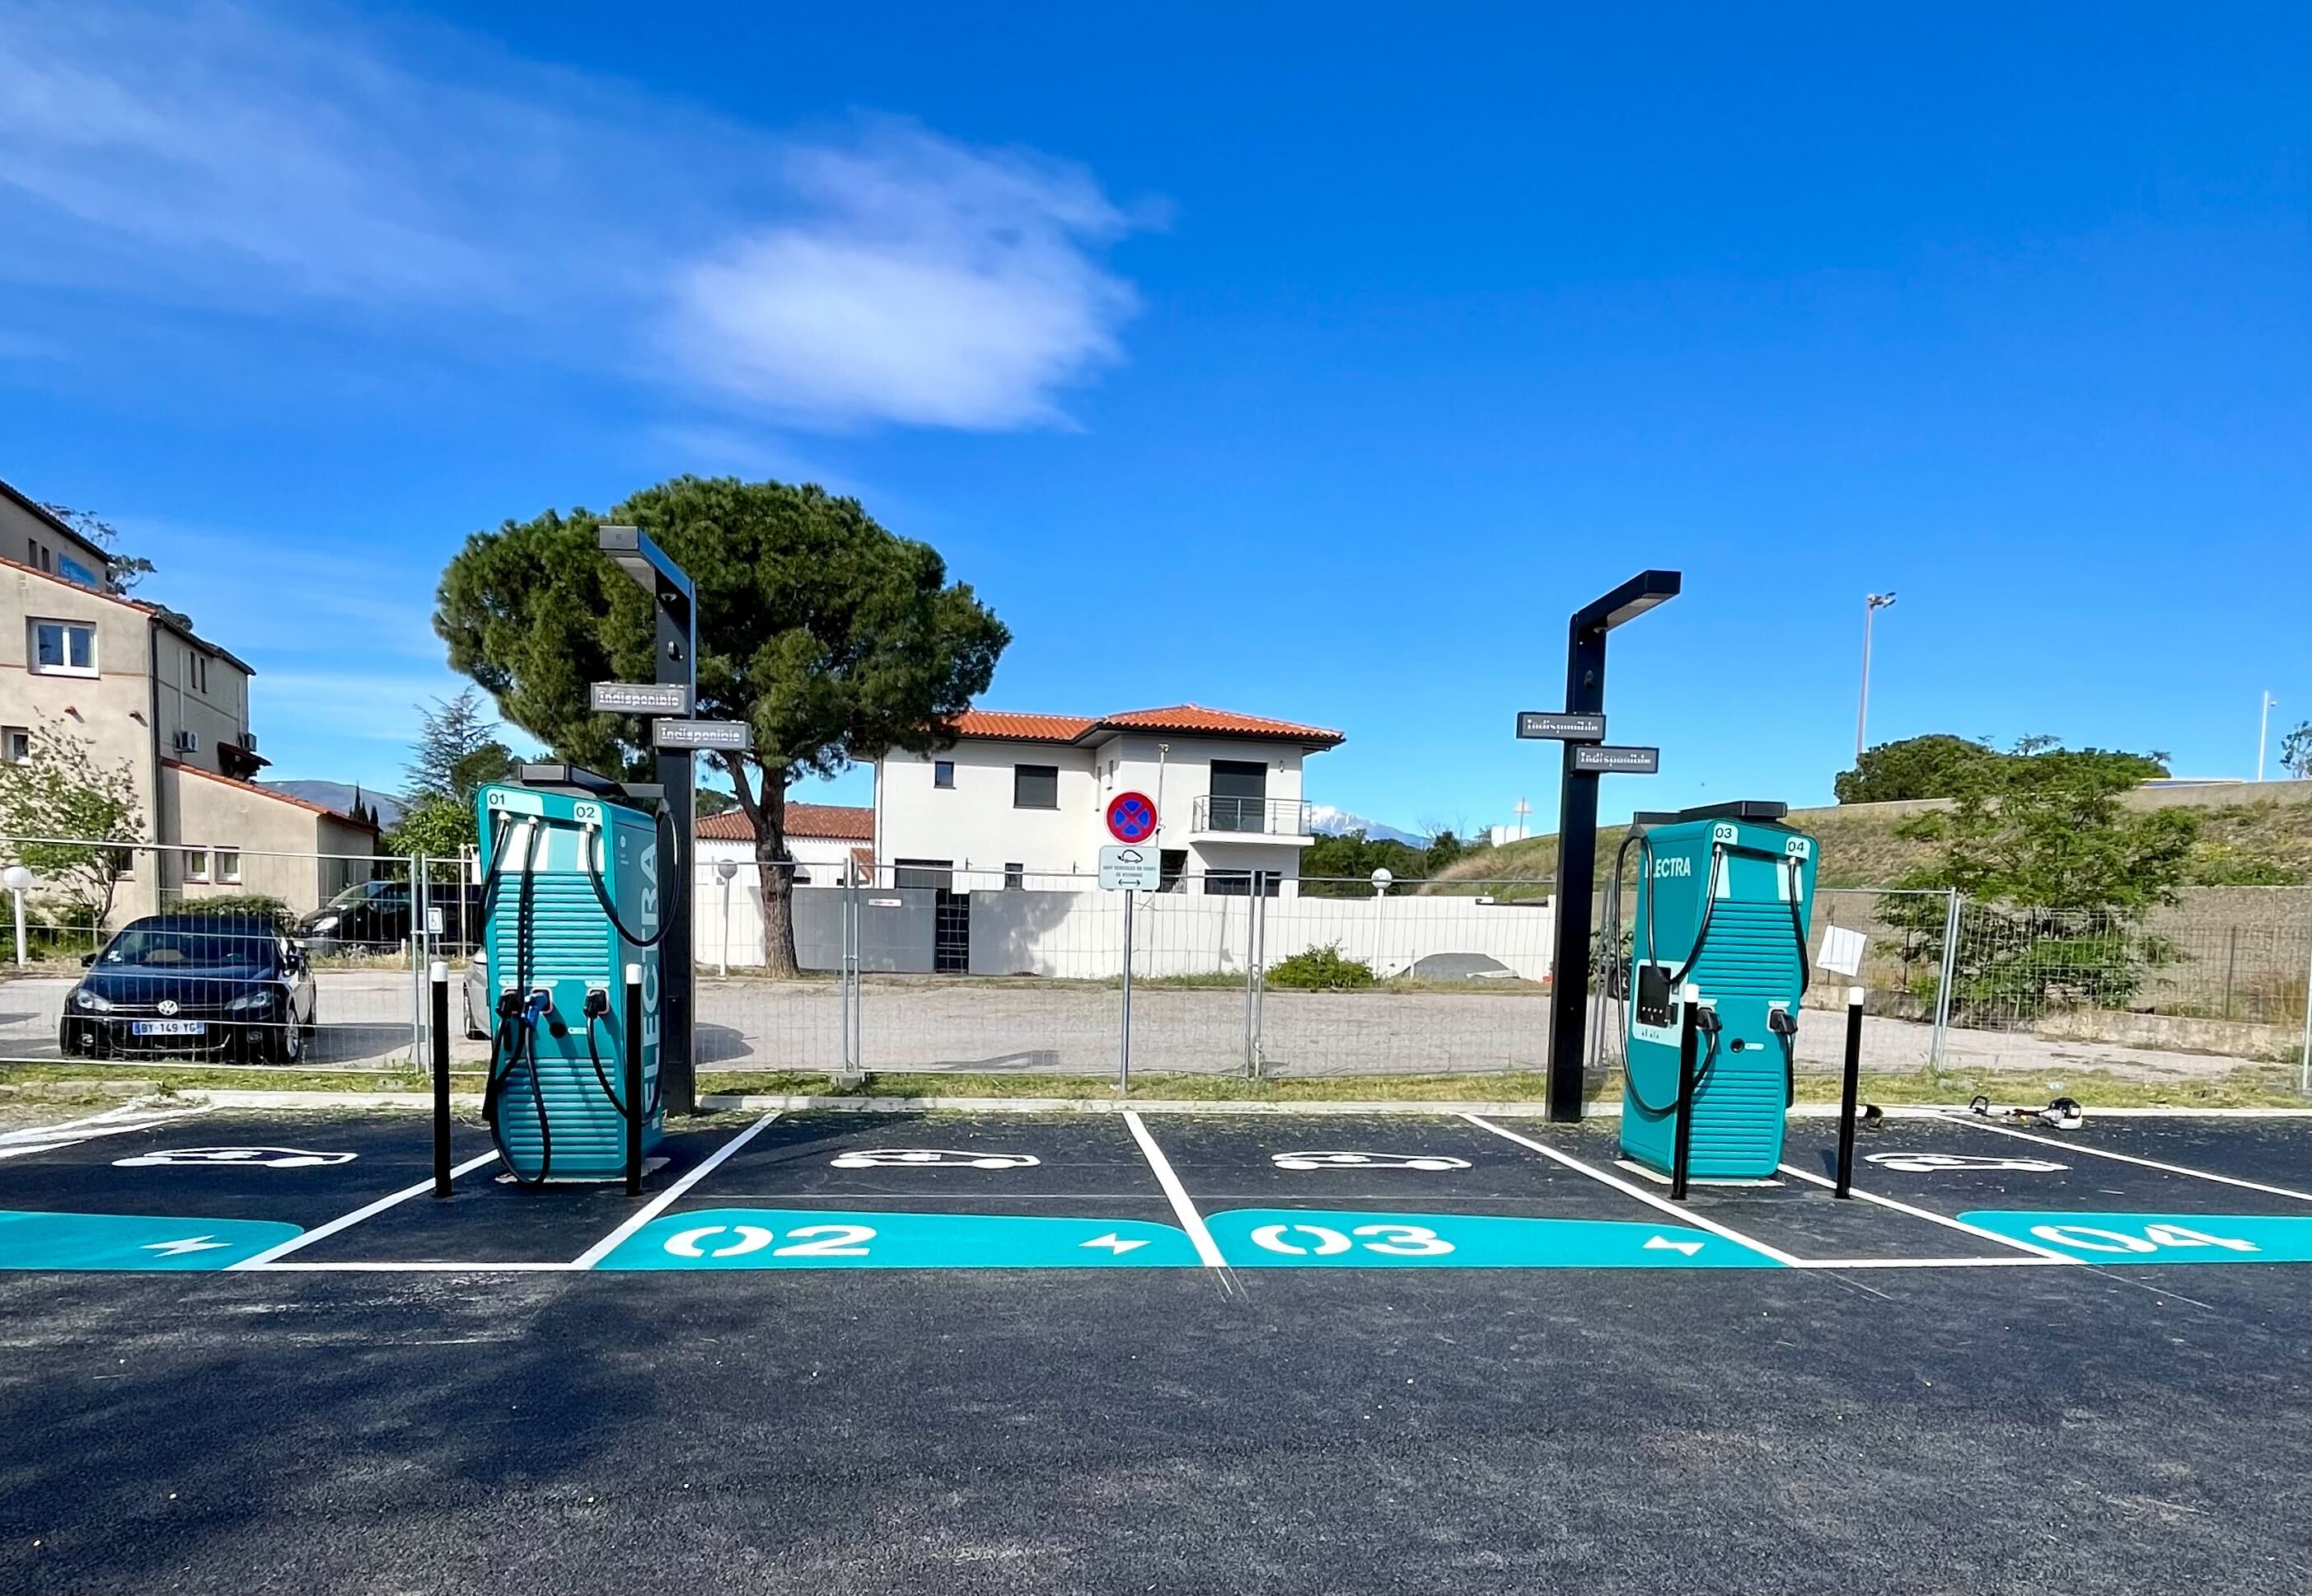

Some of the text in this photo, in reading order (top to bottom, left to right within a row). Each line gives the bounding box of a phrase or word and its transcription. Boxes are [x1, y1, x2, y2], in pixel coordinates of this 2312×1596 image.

[489, 793, 505, 806] 01
[576, 806, 596, 819] 02
[1715, 826, 1733, 839] 03
[1787, 840, 1805, 853] 04
[662, 1224, 878, 1257] 02
[1250, 1224, 1457, 1256] 03
[2029, 1224, 2263, 1253] 04
